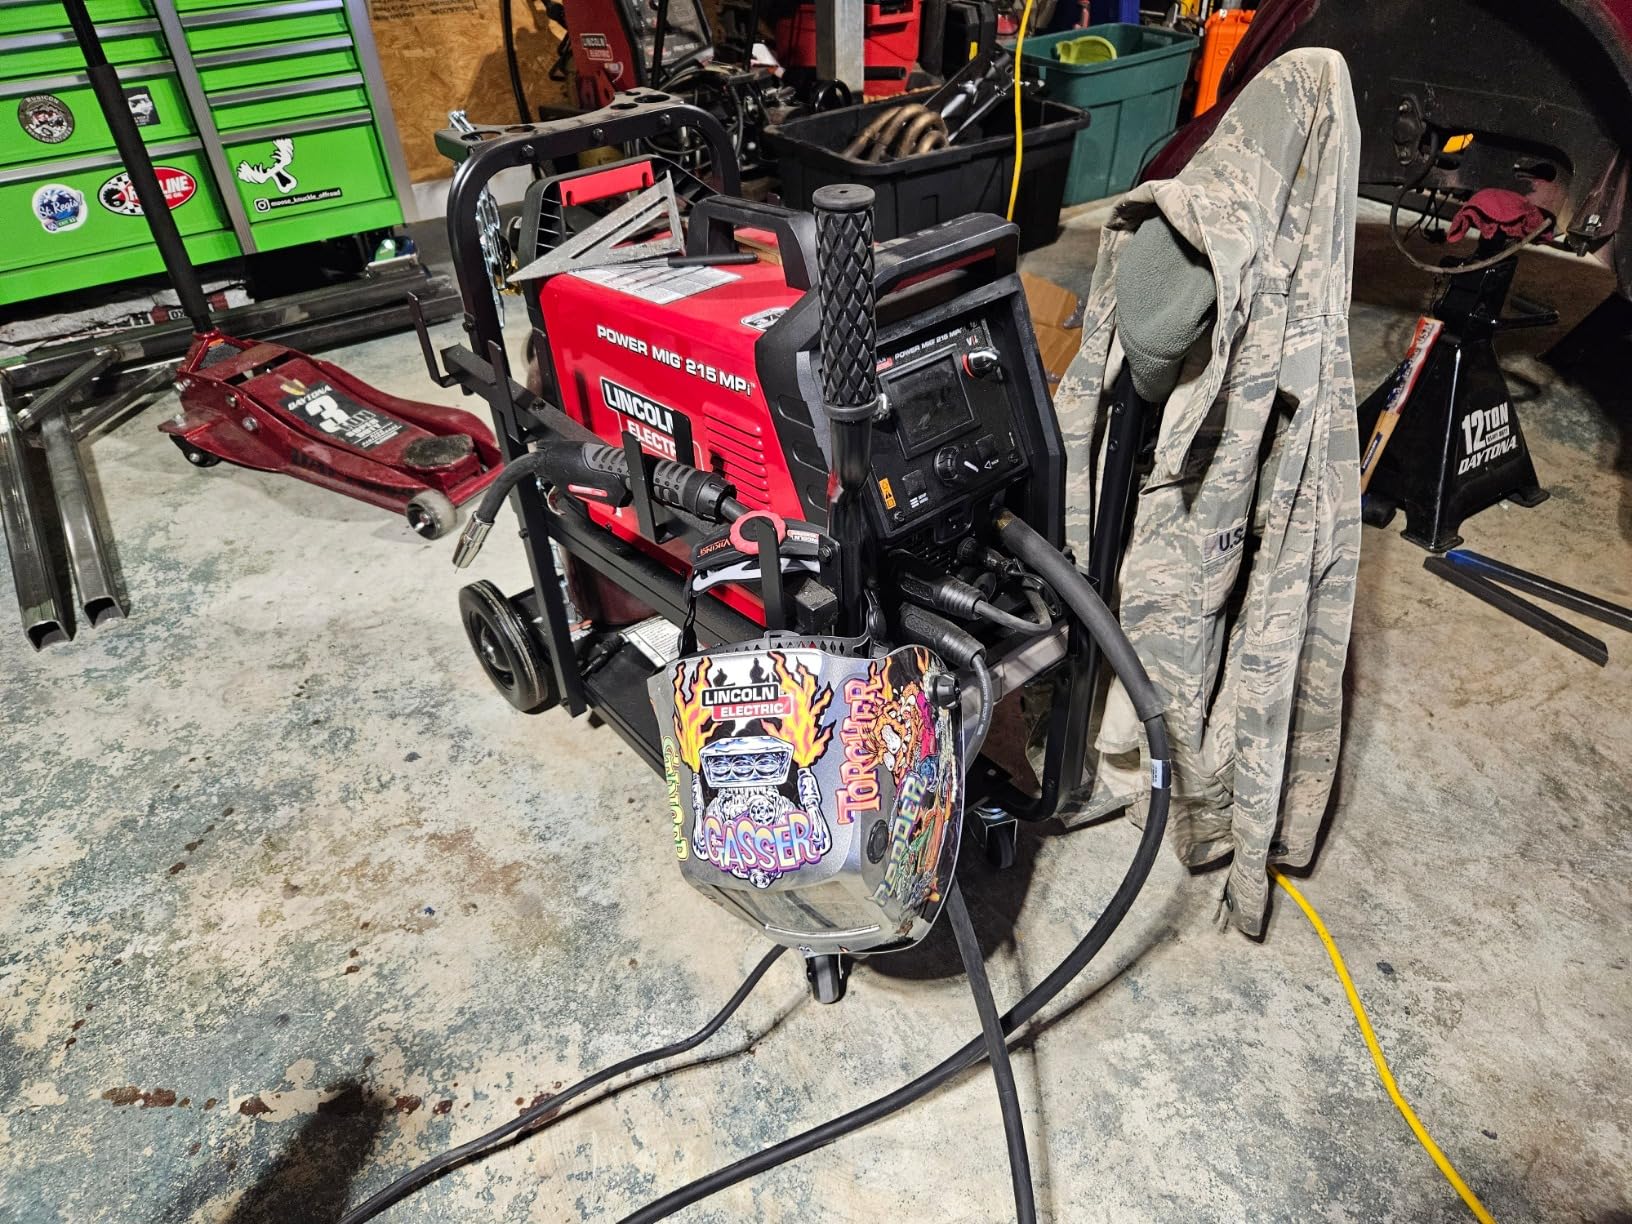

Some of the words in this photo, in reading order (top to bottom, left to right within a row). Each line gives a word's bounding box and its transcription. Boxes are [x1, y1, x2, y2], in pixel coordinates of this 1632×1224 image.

[53, 199, 80, 214] Regis
[596, 324, 648, 357] POWER
[652, 345, 682, 369] MIG
[685, 358, 718, 384] 215
[894, 345, 920, 361] POWER
[921, 340, 936, 350] MIG
[936, 333, 949, 344] 215
[287, 384, 333, 411] DAYTONA
[305, 395, 351, 433] 3
[338, 409, 377, 432] TON
[1461, 409, 1487, 456] 12
[1483, 402, 1509, 432] TON
[626, 419, 678, 458] ELECTR
[1457, 434, 1519, 475] DAYTONA
[700, 538, 731, 557] VIKING
[705, 686, 776, 705] LINCOLN
[720, 703, 785, 718] ELECTRIC
[835, 676, 885, 826] TORCHER
[703, 812, 816, 872] GASSER
